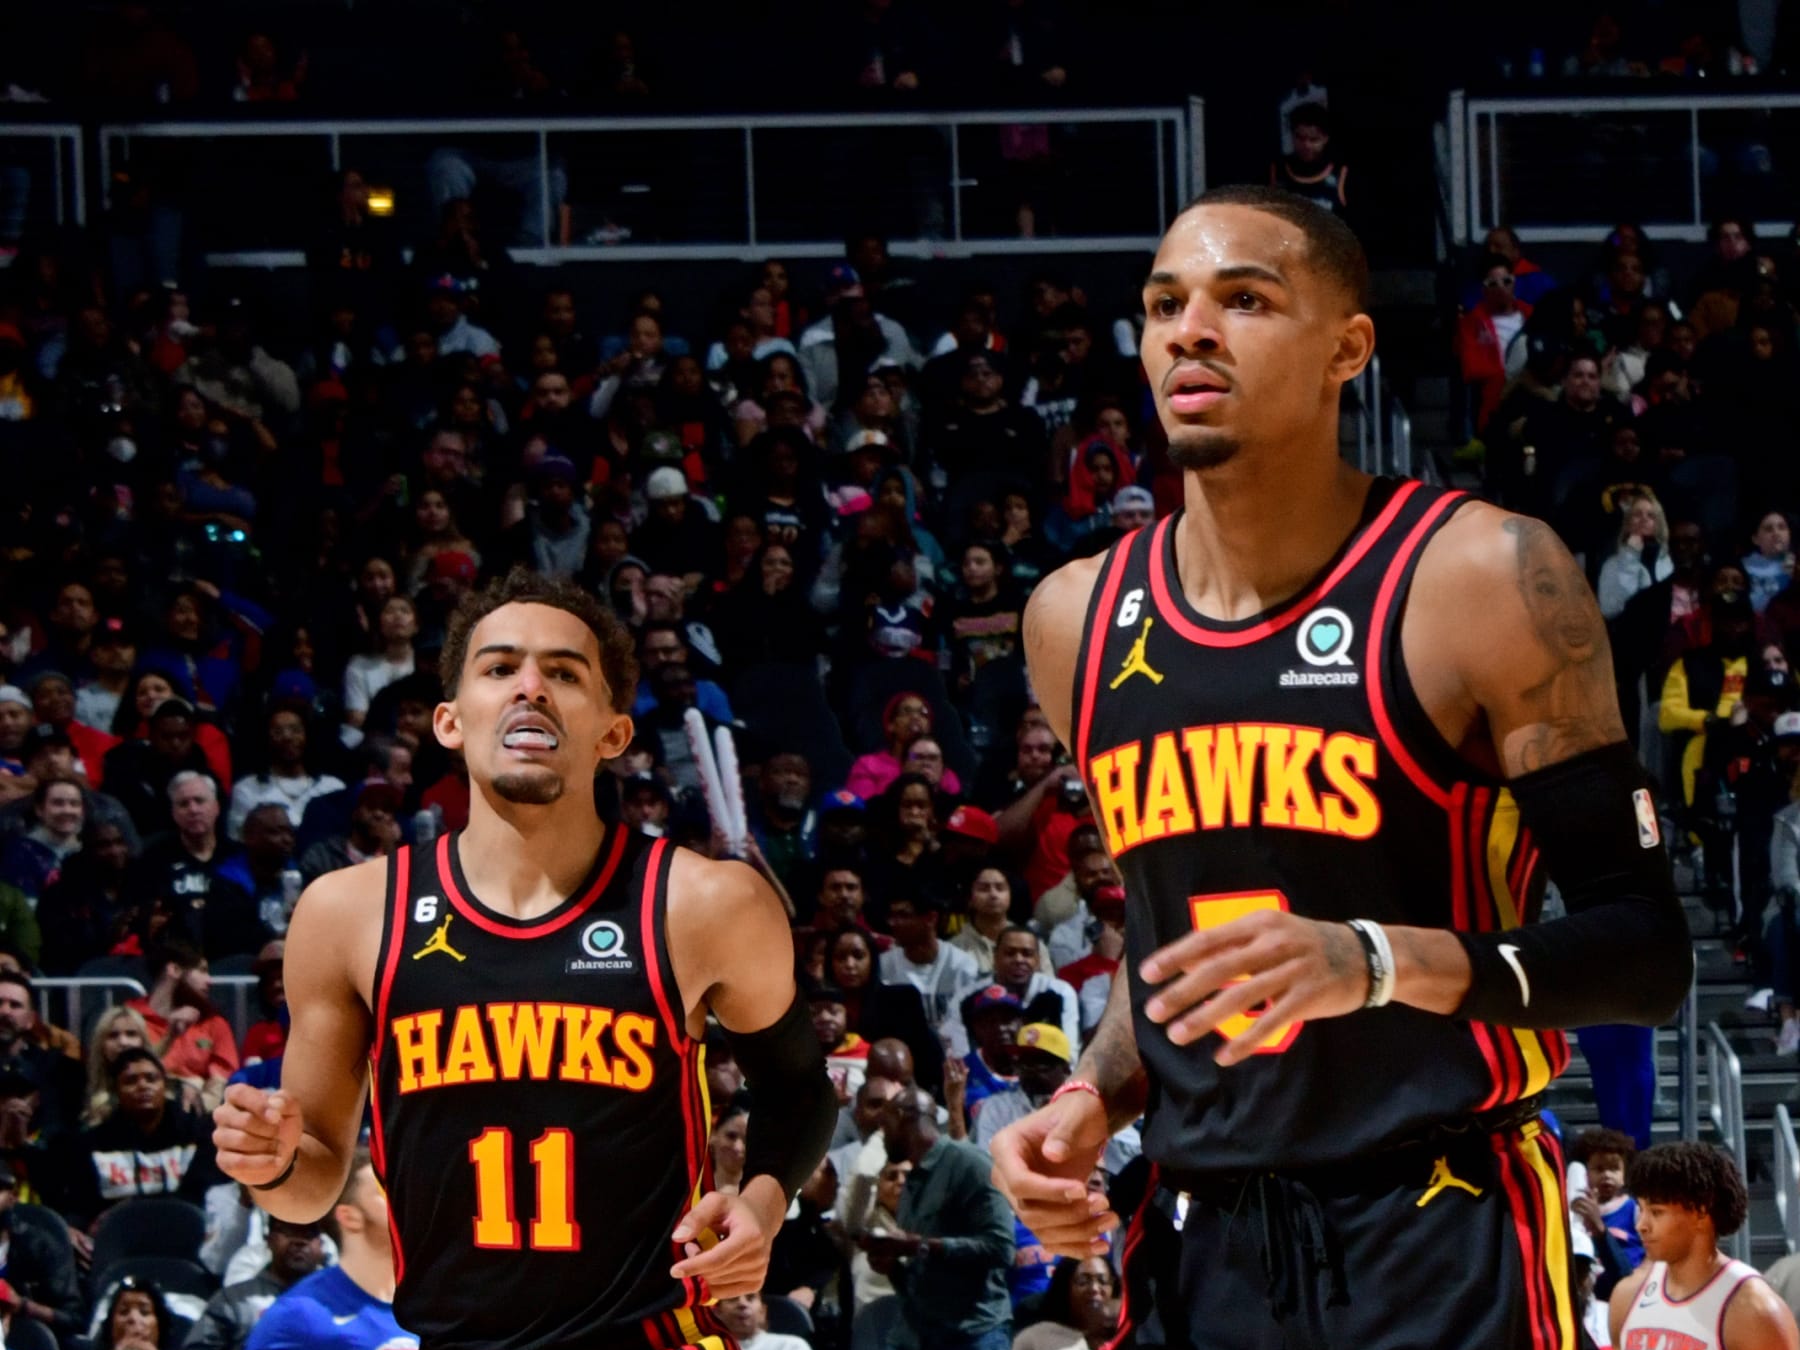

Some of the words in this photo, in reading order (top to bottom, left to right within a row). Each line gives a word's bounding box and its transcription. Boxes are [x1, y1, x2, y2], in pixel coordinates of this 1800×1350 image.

[1116, 588, 1144, 627] 6
[1278, 669, 1360, 686] sharecare
[1088, 721, 1383, 859] HAWKS
[414, 895, 439, 923] 6
[570, 958, 633, 970] sharecare
[392, 1001, 657, 1095] HAWKS
[467, 1125, 582, 1252] 11
